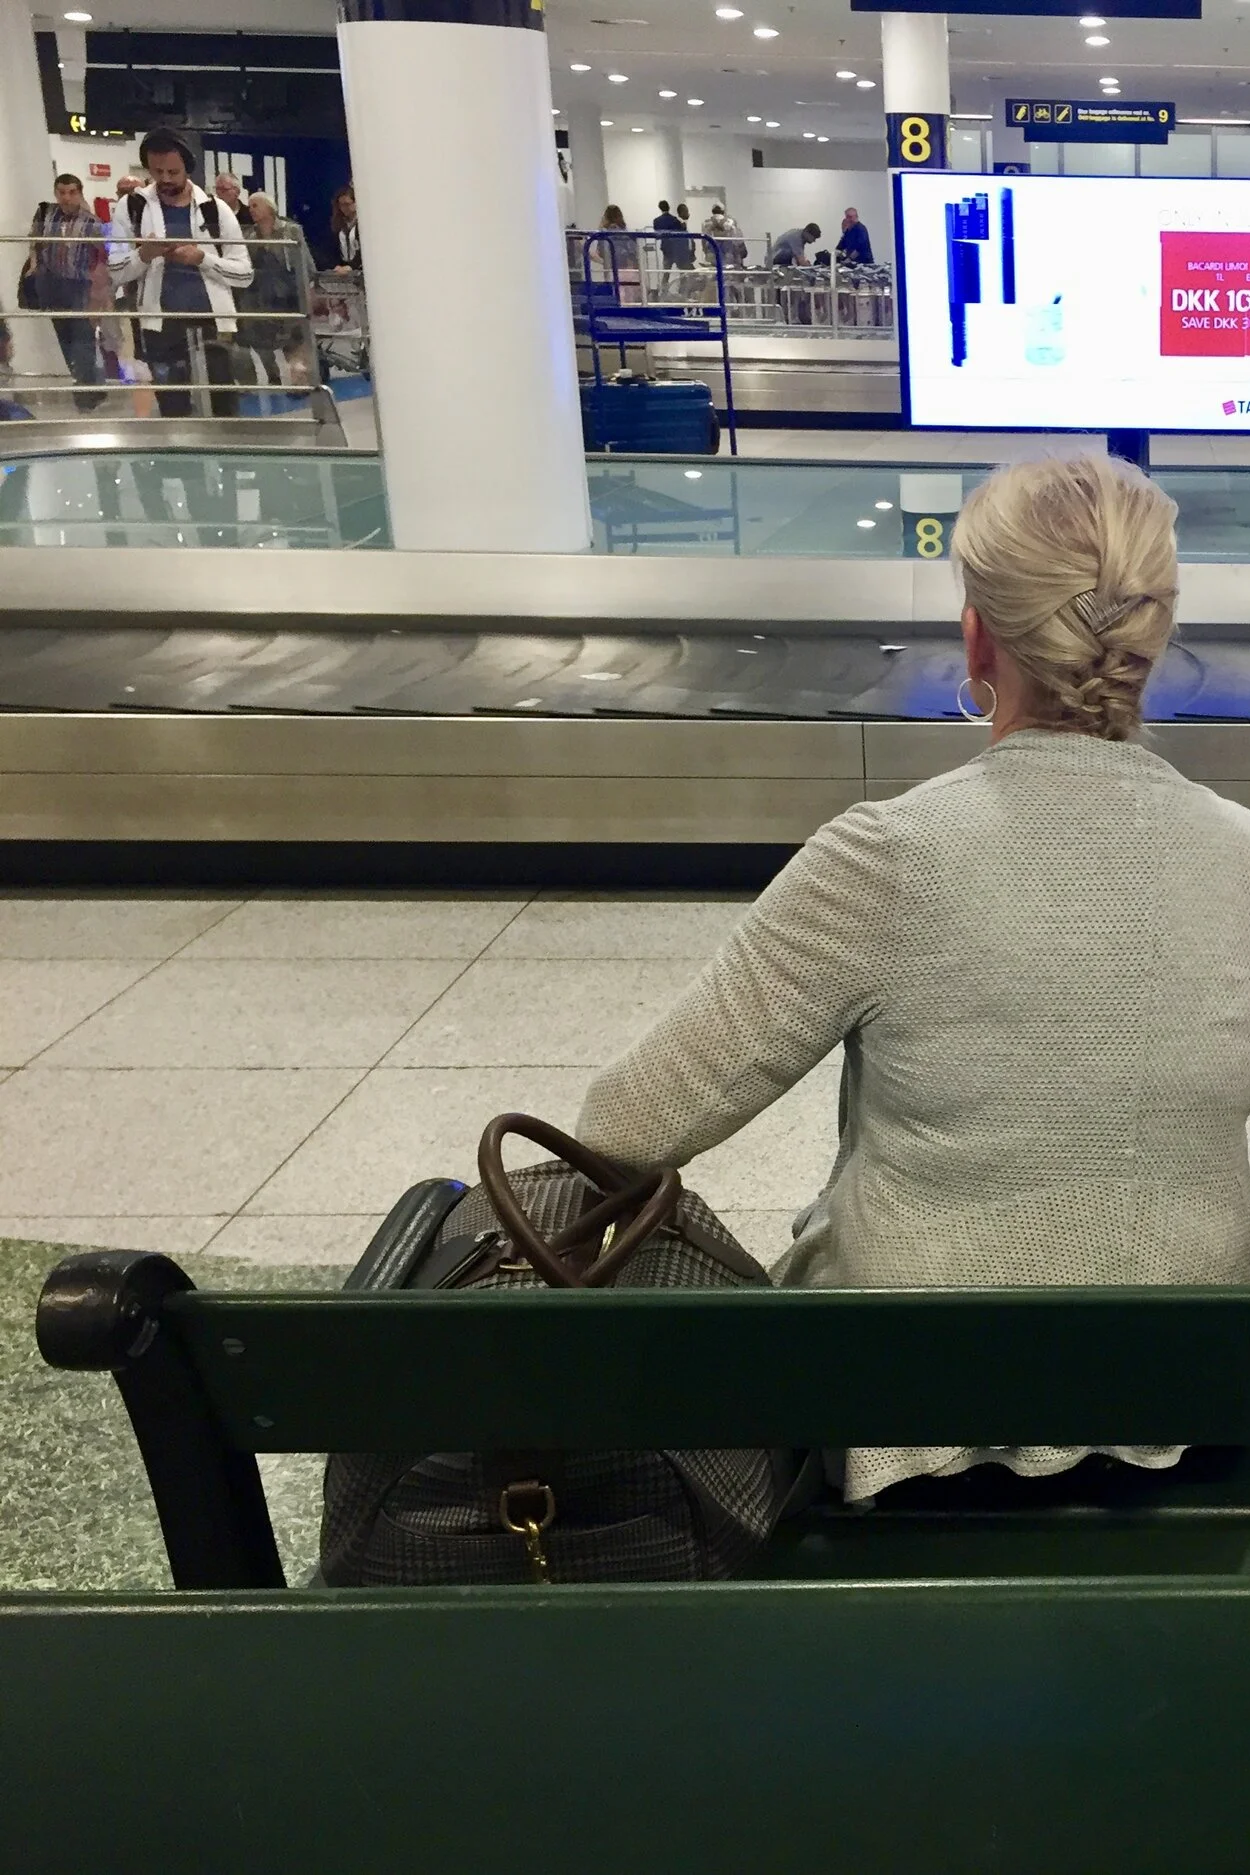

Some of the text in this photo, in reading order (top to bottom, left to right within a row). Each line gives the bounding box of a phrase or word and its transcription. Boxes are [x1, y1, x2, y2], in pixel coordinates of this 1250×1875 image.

[1158, 109, 1169, 123] 9
[901, 116, 931, 163] 8
[1172, 288, 1221, 312] DKK
[1181, 316, 1211, 329] SAVE
[1213, 316, 1239, 329] DKK
